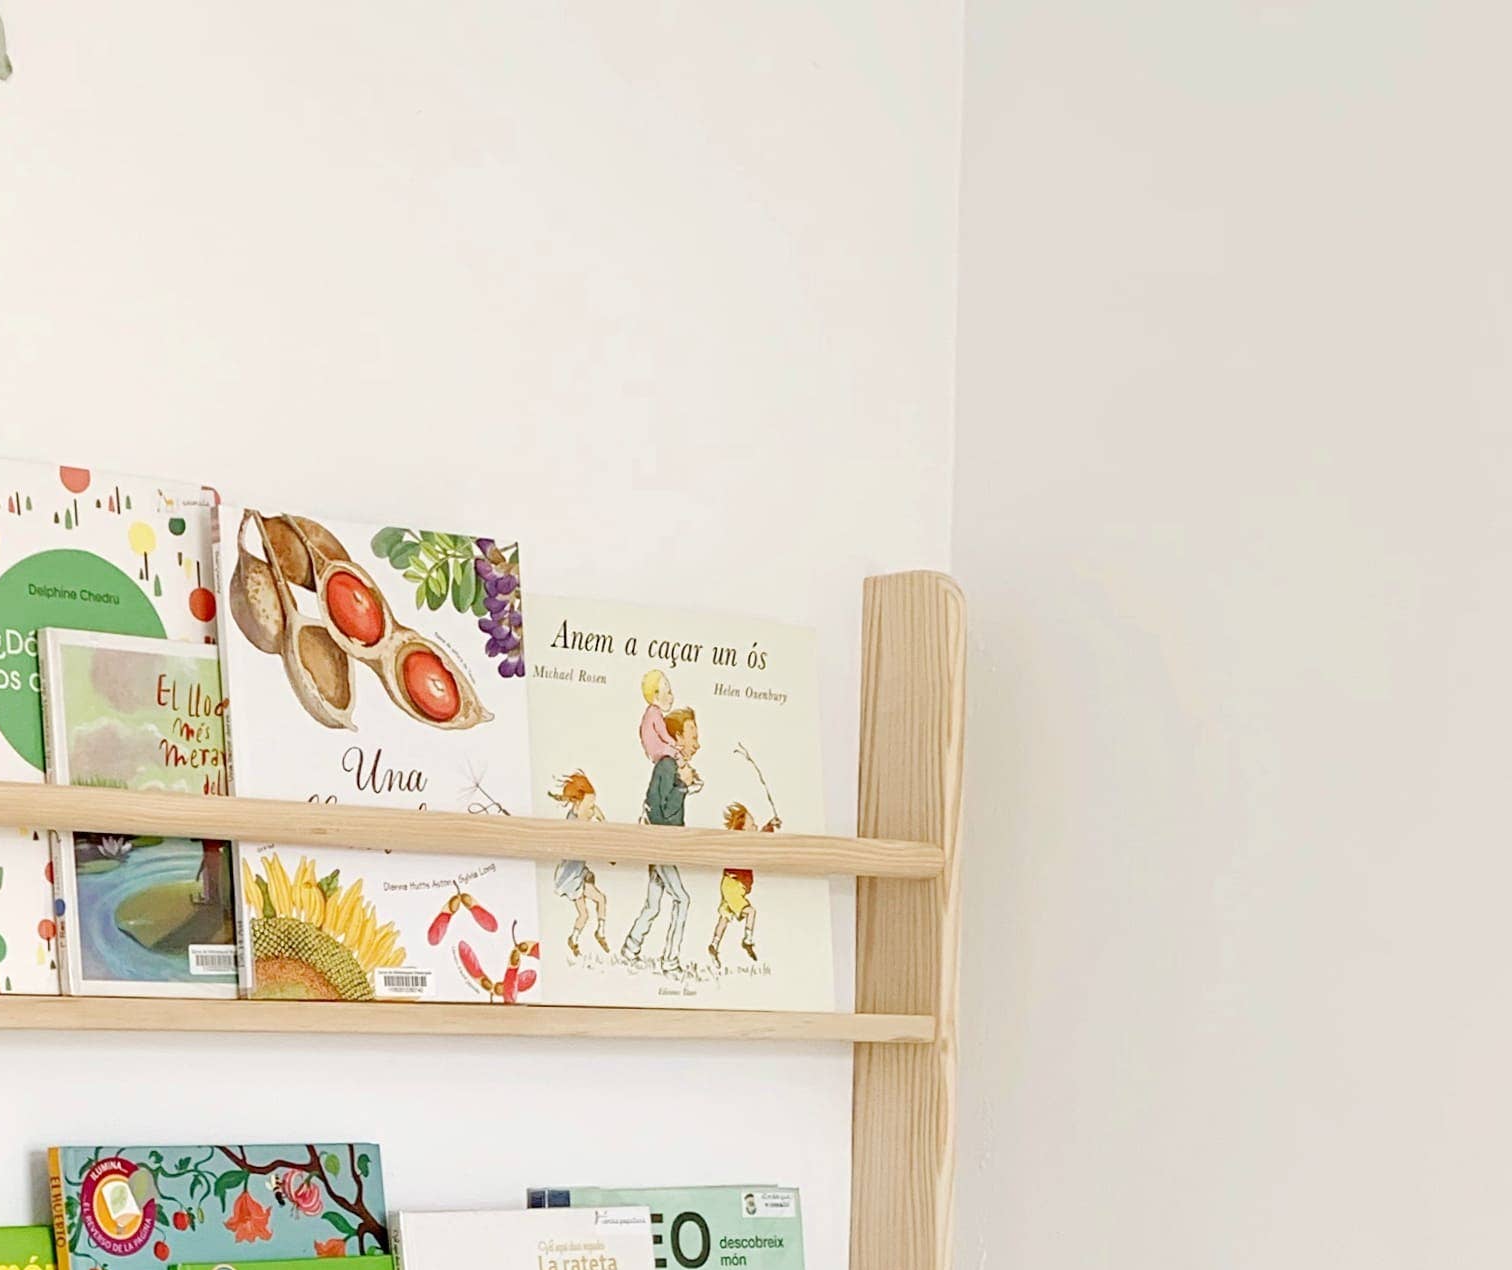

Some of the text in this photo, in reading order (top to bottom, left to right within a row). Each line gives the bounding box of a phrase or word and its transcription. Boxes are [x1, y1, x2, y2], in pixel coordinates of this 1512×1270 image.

[28, 582, 120, 605] Delphine Chedru
[550, 619, 768, 670] Anem a caçar un ós
[532, 664, 607, 685] Michael Rosen
[157, 673, 179, 711] El
[713, 683, 788, 705] Helen Oxenbury
[342, 746, 427, 794] Una
[51, 1193, 66, 1248] HUERTO
[719, 1235, 784, 1250] descobreix
[720, 1253, 747, 1266] món
